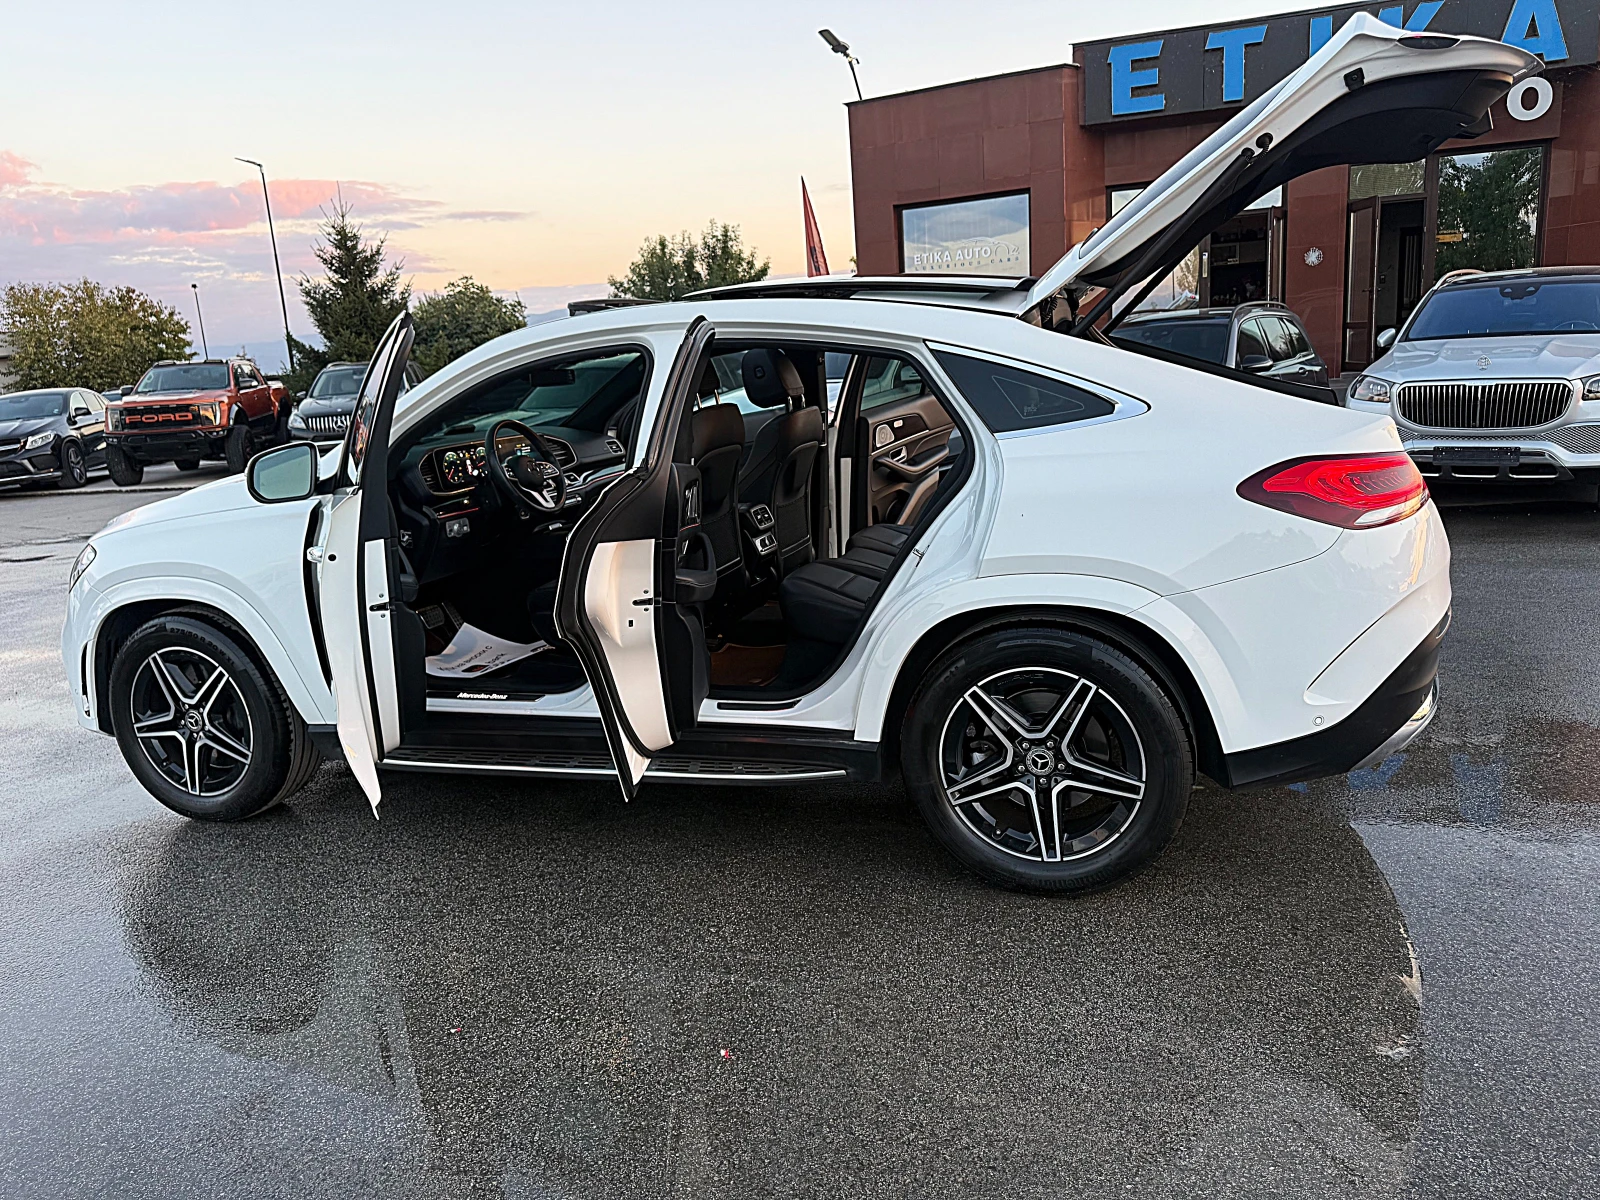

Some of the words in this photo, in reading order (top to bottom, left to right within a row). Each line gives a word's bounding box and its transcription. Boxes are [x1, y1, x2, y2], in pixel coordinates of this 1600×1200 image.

[913, 251, 952, 265] ETIKA
[955, 246, 992, 261] AUTO
[990, 256, 1020, 264] CARS
[125, 412, 193, 424] FORD
[170, 627, 199, 639] 275/50
[207, 640, 218, 651] 20
[457, 692, 508, 700] Mercedes-Benz
